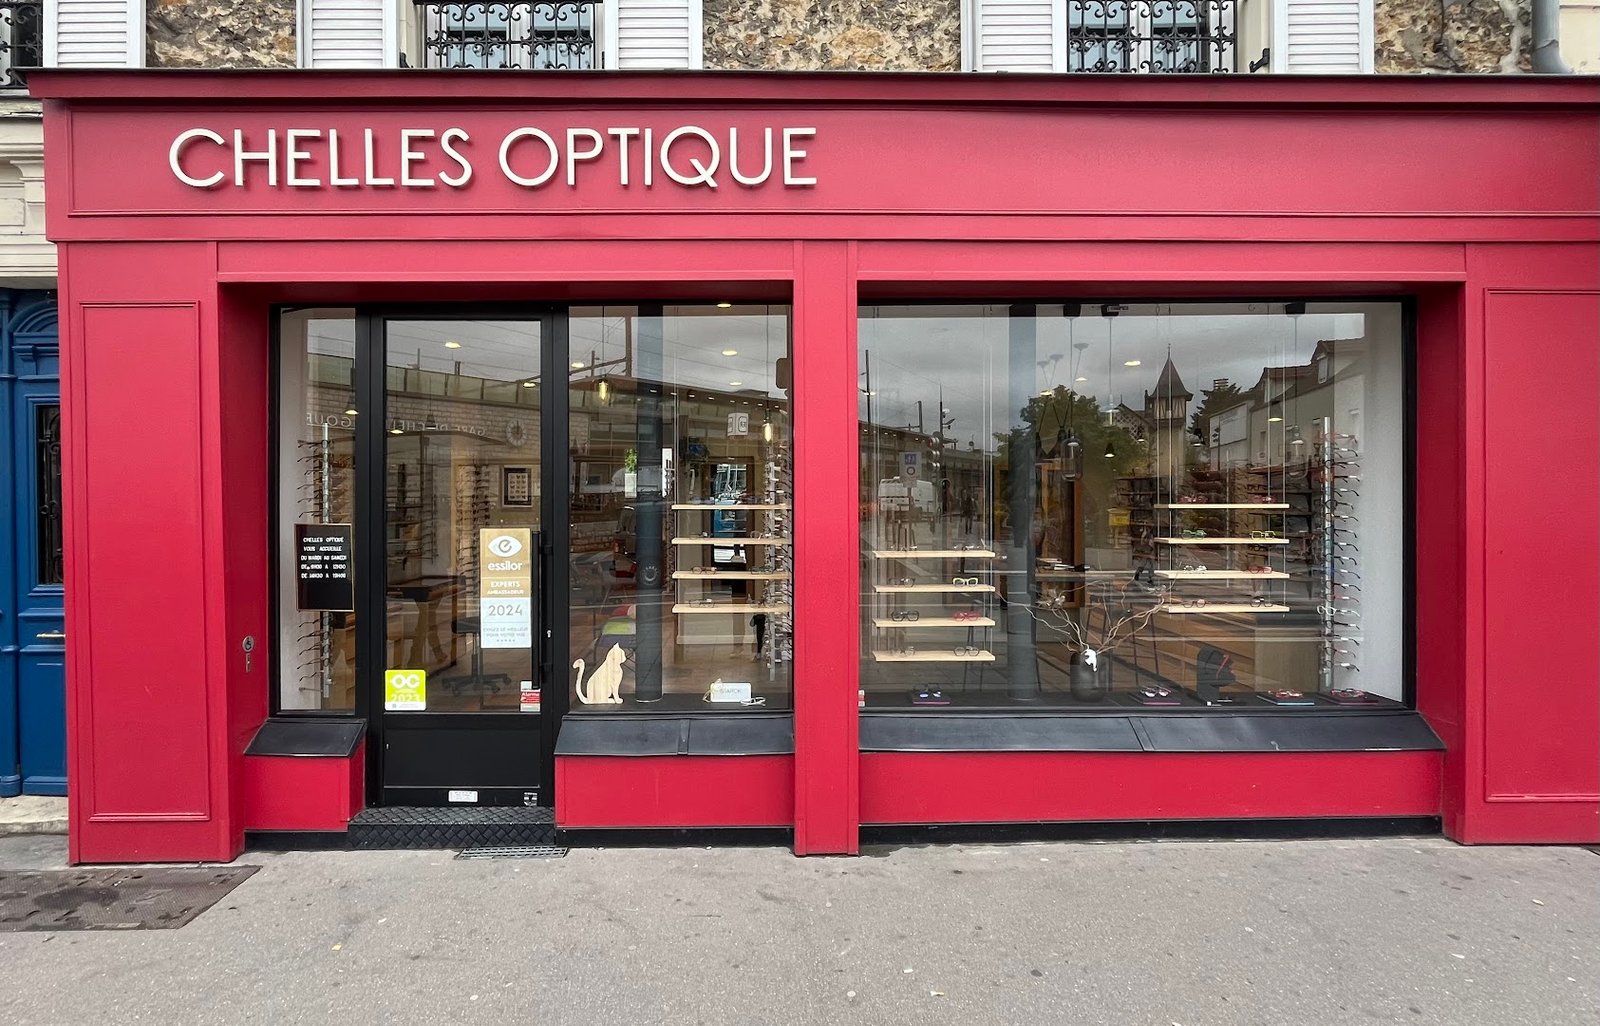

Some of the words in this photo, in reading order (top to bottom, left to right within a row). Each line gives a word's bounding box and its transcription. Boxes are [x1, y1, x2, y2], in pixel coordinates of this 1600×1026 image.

[168, 127, 473, 188] CHELLES
[498, 125, 818, 189] OPTIQUE
[487, 561, 523, 571] essilor
[488, 604, 523, 617] 2024
